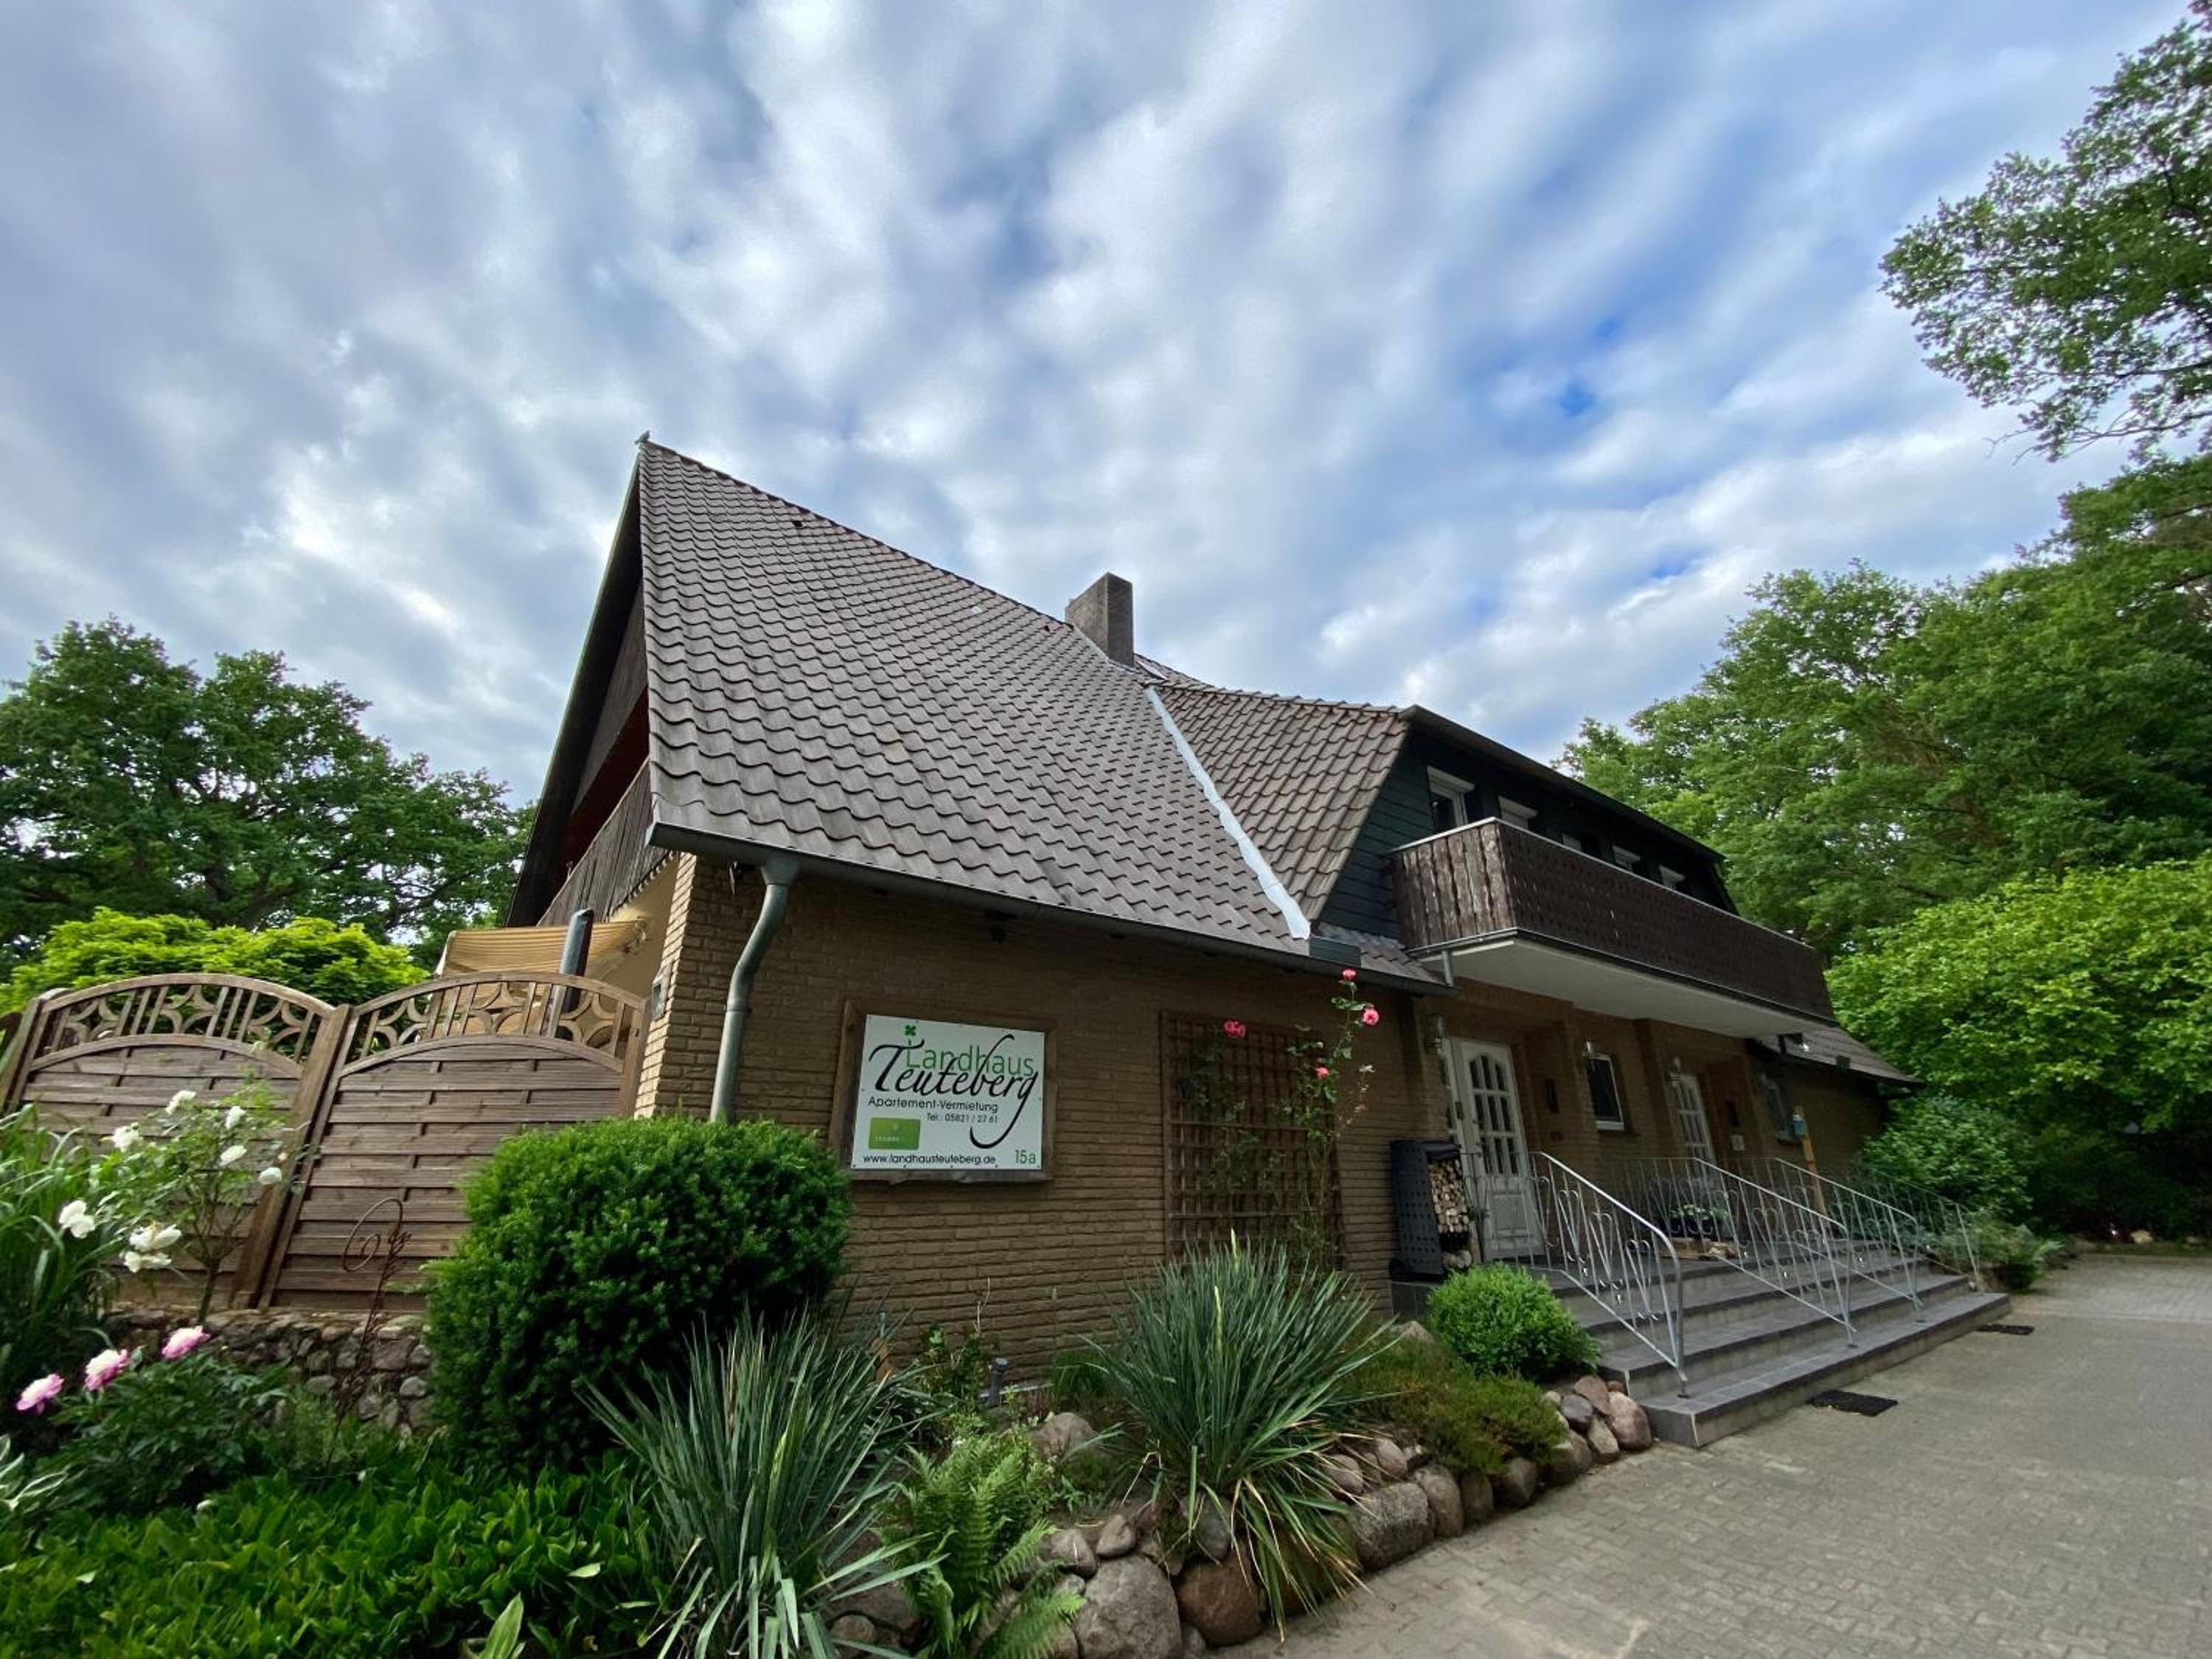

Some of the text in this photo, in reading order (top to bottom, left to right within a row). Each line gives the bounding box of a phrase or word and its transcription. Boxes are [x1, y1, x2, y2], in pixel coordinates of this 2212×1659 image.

[906, 1042, 1034, 1077] Landhaus
[869, 1034, 1038, 1149] Teuteberg
[868, 1096, 998, 1114] Apartement-Vermietung
[863, 1153, 996, 1165] www.landhausteuteberg.de
[1015, 1150, 1036, 1164] 15a
